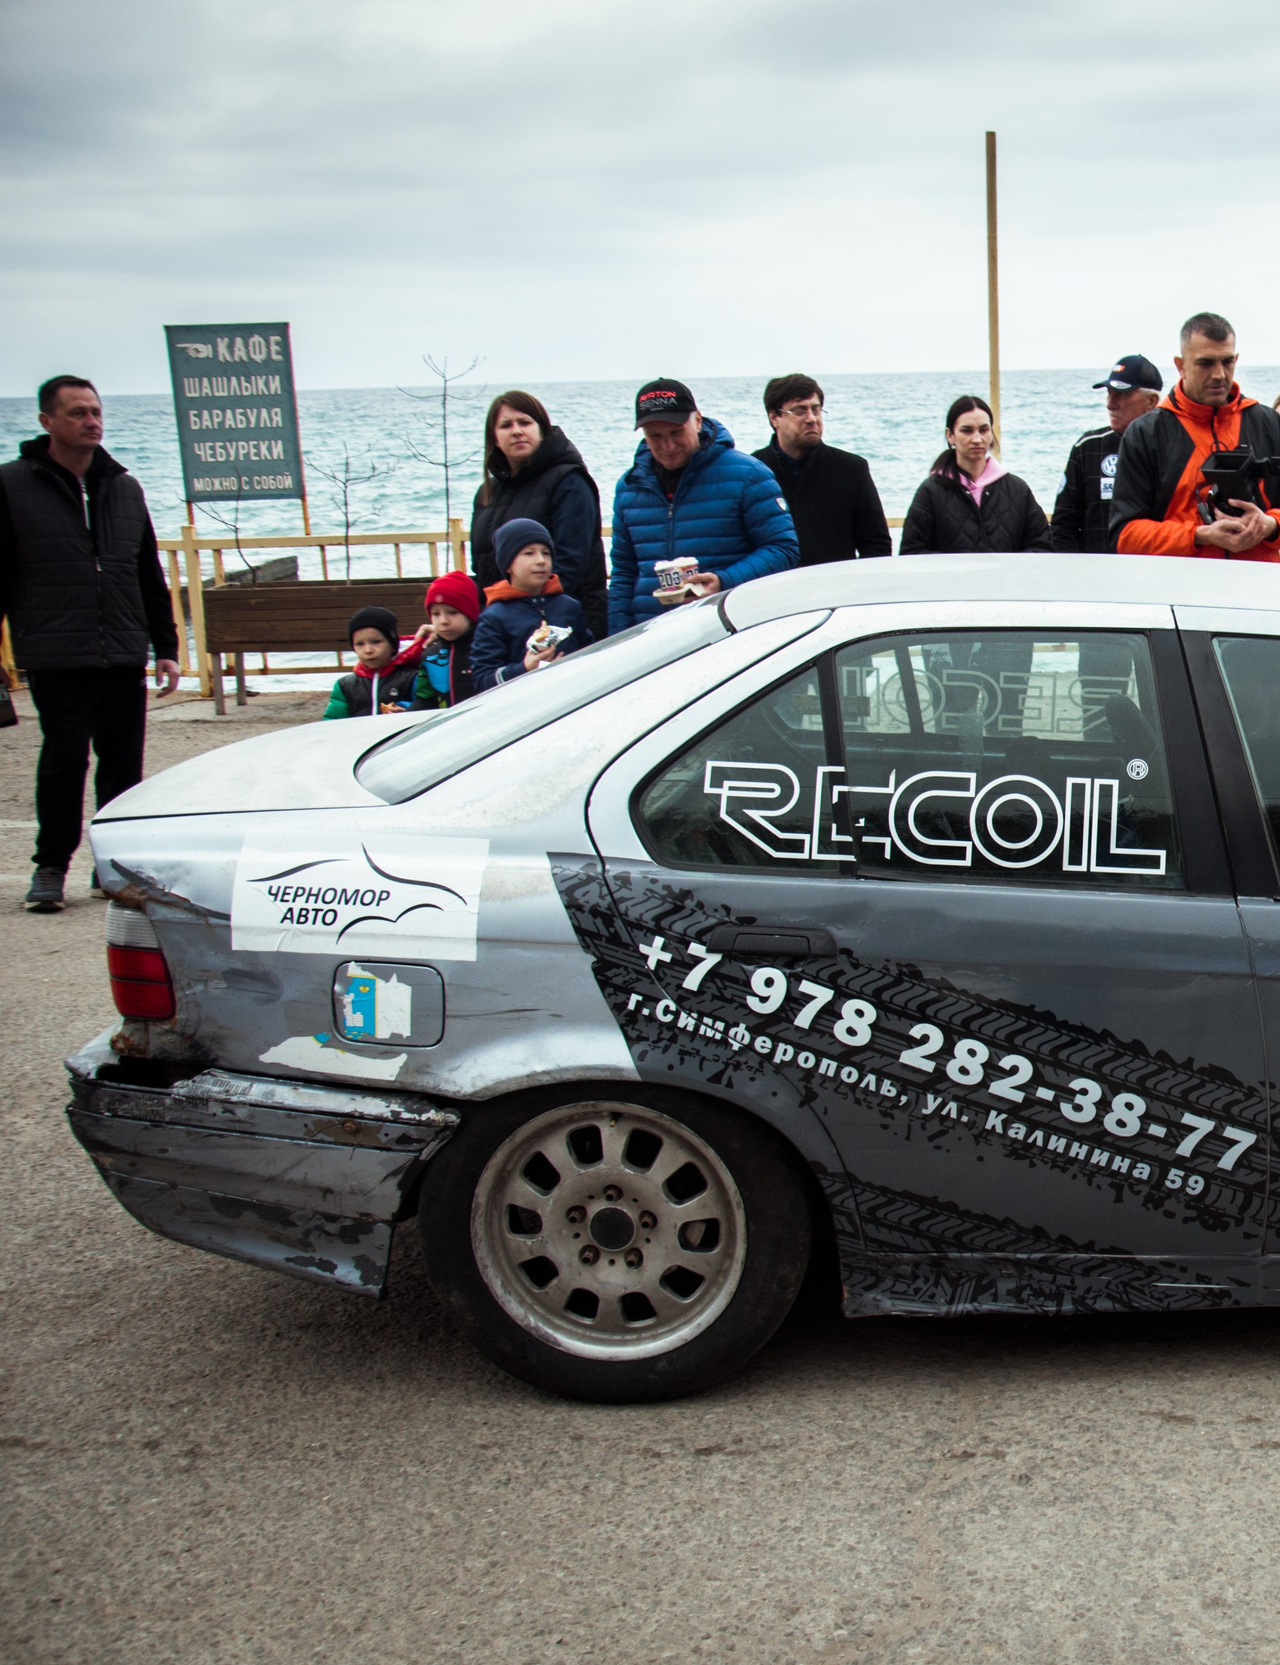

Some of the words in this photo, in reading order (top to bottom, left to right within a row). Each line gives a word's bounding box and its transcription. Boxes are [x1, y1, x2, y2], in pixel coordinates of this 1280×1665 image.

[216, 334, 285, 364] КАФЕ
[183, 375, 282, 397] ШАШЛЫКИ
[639, 397, 678, 407] SENNA
[189, 408, 283, 430] БАРАБУЛЯ
[194, 440, 285, 462] ЧЕБУРЕКИ
[194, 476, 238, 492] МОЖНО
[241, 476, 250, 490] С
[254, 472, 292, 489] СОБОЙ
[659, 571, 680, 588] 203
[704, 760, 1167, 876] RECOIL
[267, 885, 391, 907] ЧЕРНОМОР
[280, 908, 338, 926] АВТО
[638, 935, 723, 991] +7
[746, 967, 877, 1047] 978
[899, 1023, 1258, 1171] 282-38-77
[921, 1093, 969, 1123] ул.
[984, 1110, 1151, 1180] Калинина
[1165, 1168, 1205, 1196] 59
